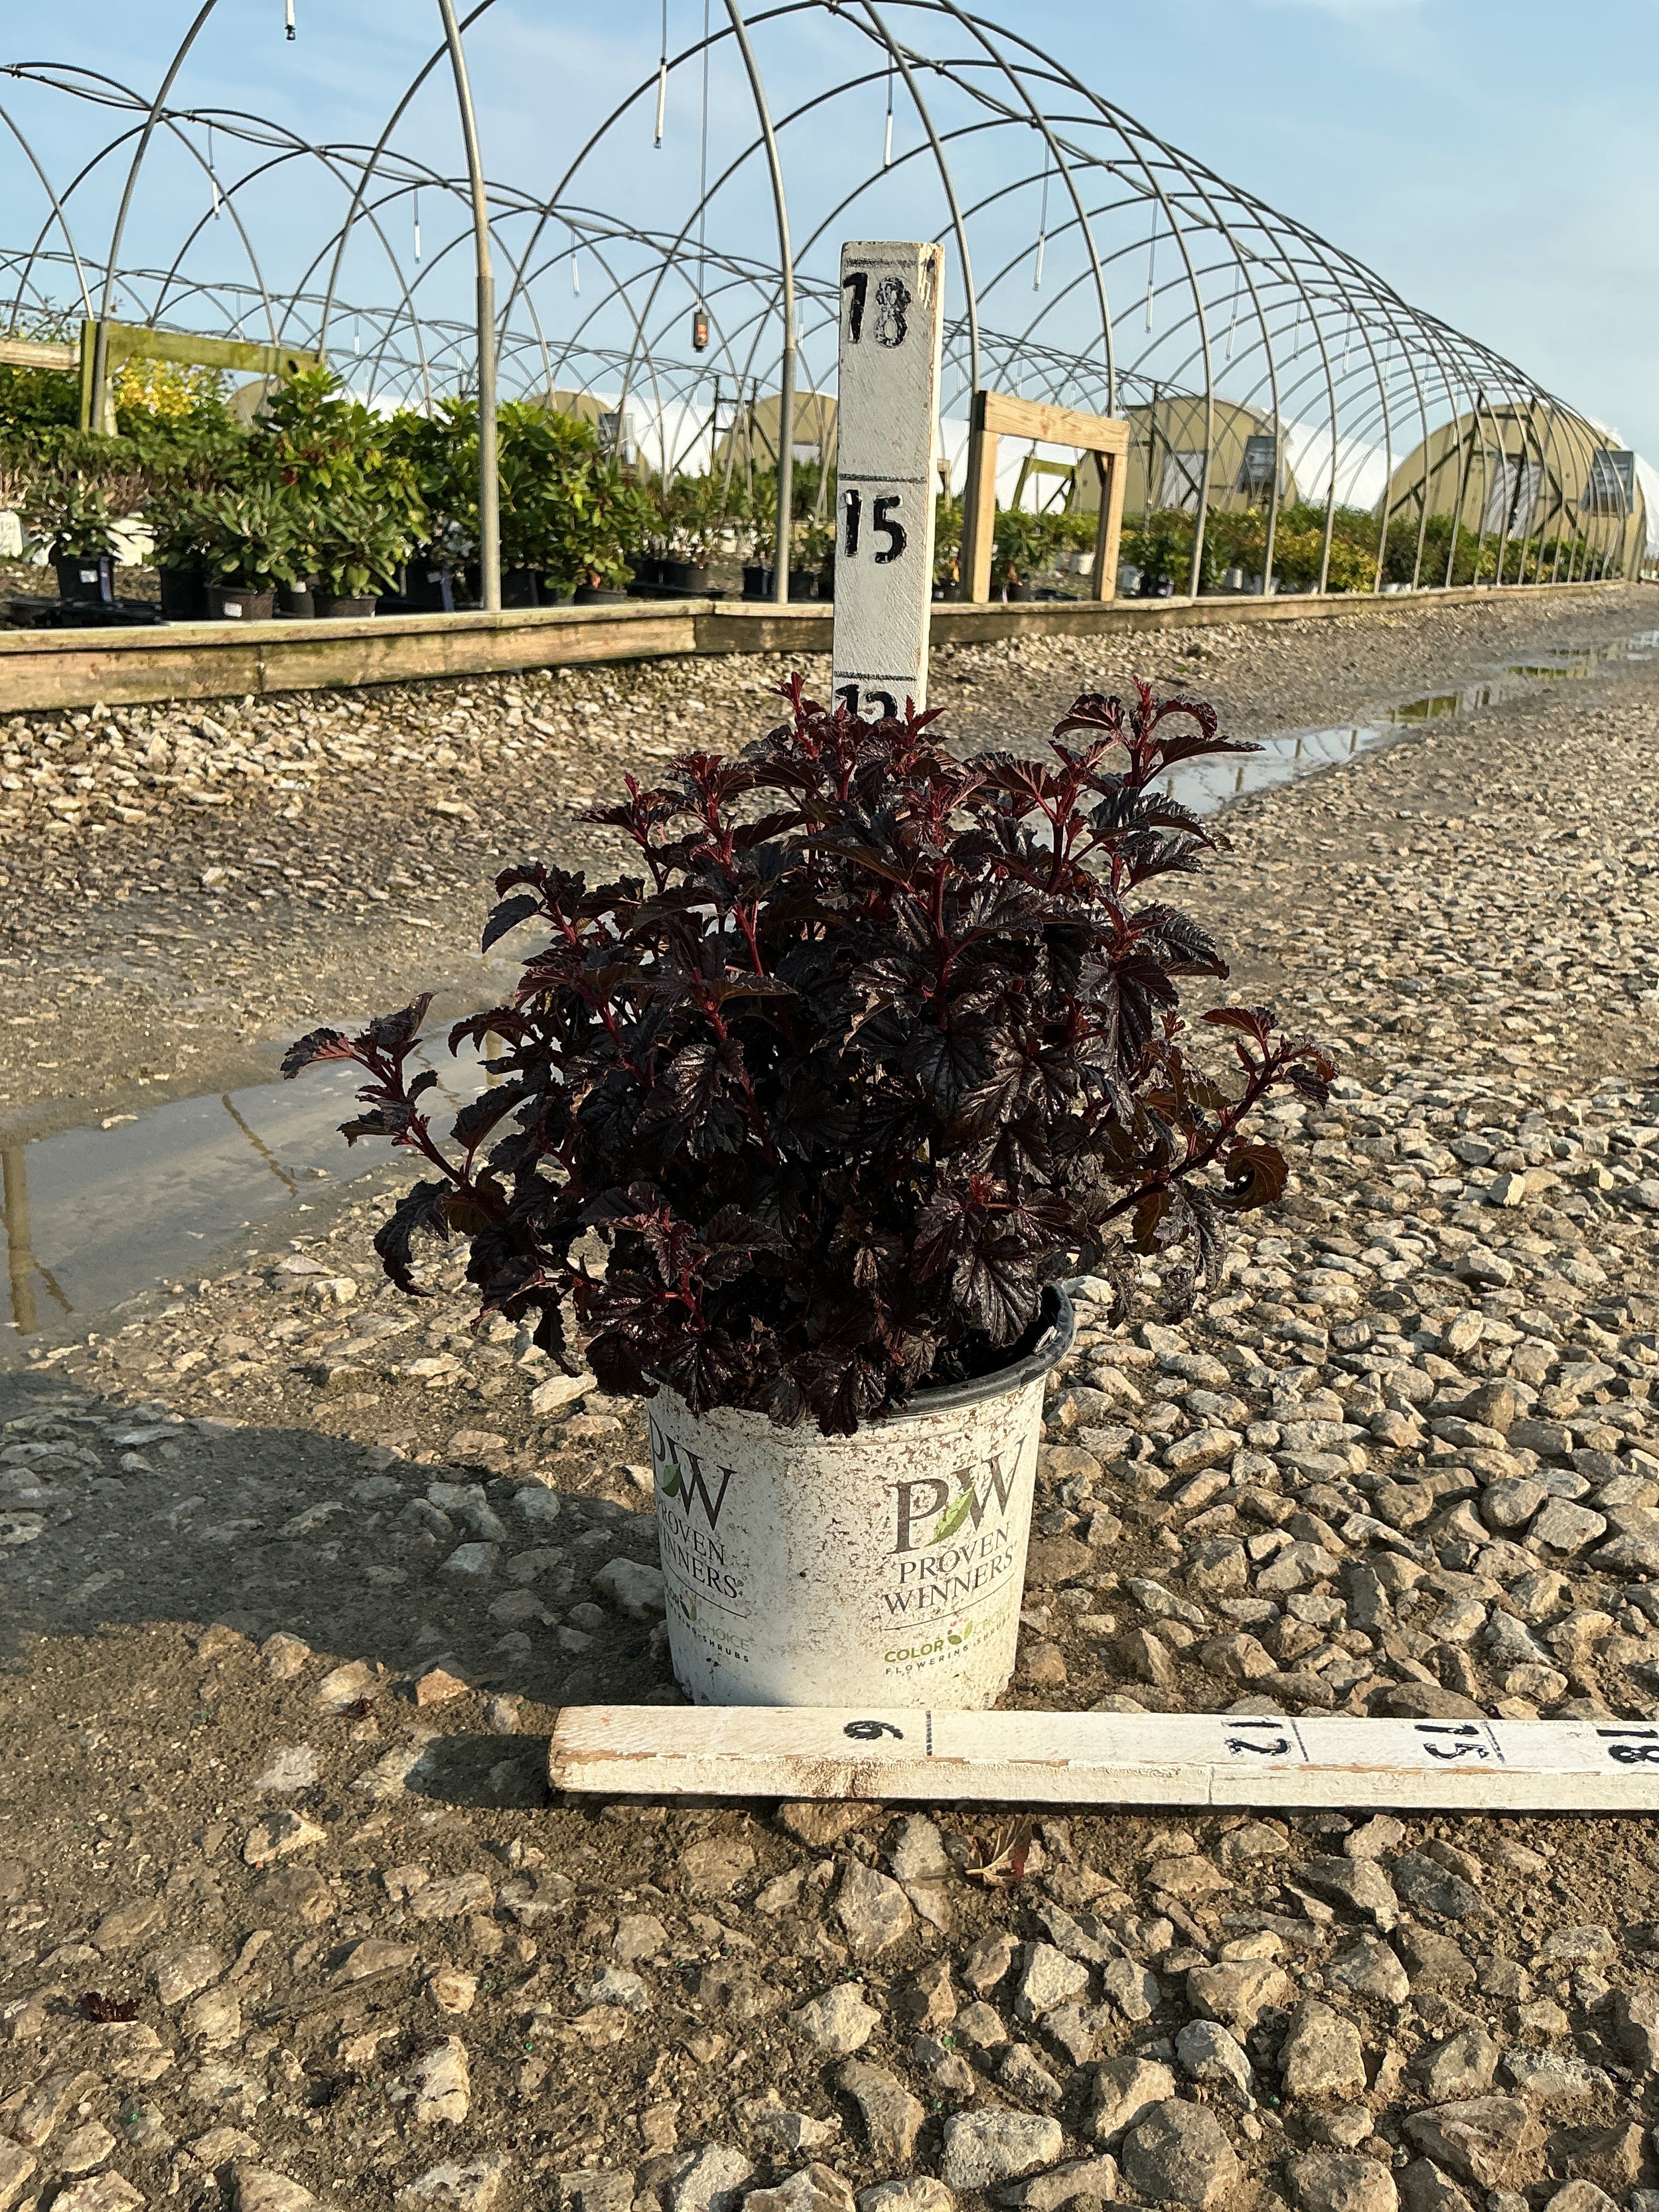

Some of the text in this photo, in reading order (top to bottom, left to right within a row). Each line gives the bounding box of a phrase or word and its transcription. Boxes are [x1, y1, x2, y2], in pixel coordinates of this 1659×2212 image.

[842, 272, 912, 349] 18
[839, 489, 907, 564] 15
[887, 1434, 1027, 1554] PW
[661, 1524, 737, 1598] INNERS
[899, 1522, 1010, 1584] PROVEN
[884, 1545, 1013, 1614] WINNERS
[699, 1618, 749, 1651] CHOICE
[703, 1635, 749, 1662] SHRUBS
[884, 1639, 944, 1662] COLOR
[885, 1645, 968, 1674] FLOWERING
[1222, 1719, 1291, 1756] 12
[1414, 1724, 1490, 1759] 15
[1596, 1728, 1659, 1763] 18
